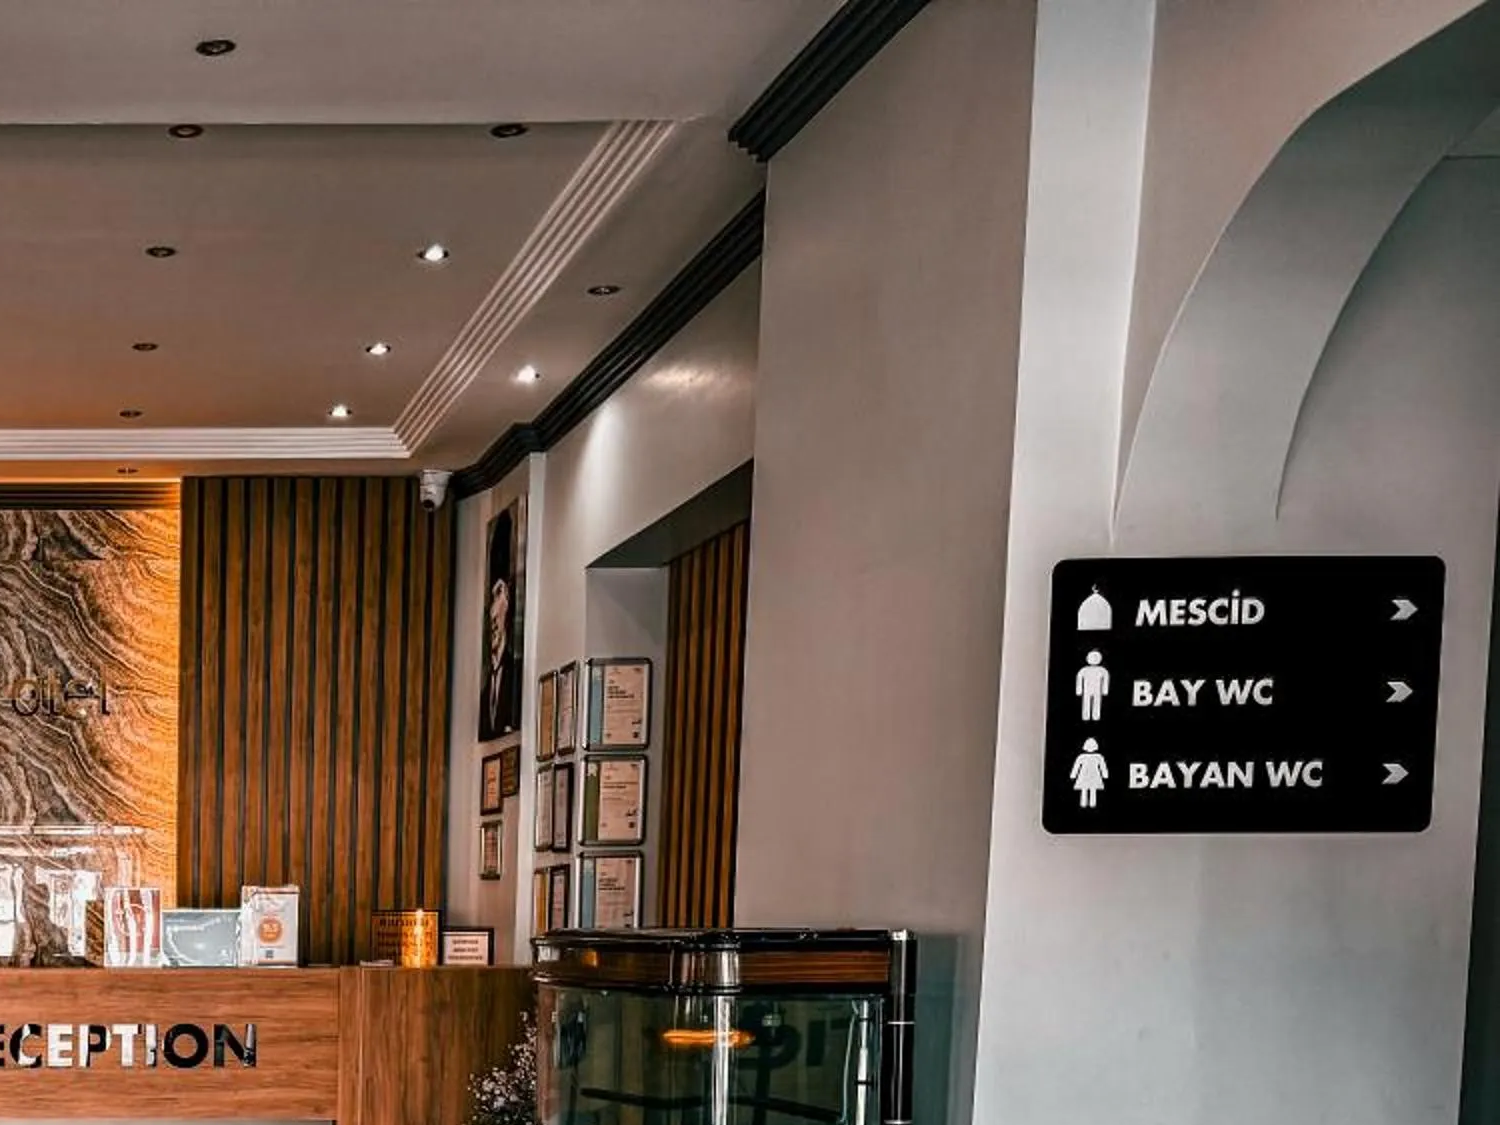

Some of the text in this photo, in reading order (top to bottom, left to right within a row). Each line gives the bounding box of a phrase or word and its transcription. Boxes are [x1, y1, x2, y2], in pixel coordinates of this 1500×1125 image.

[1135, 589, 1265, 626] MESCİD
[1132, 679, 1274, 707] BAY WC
[1128, 761, 1324, 789] BAYAN WC
